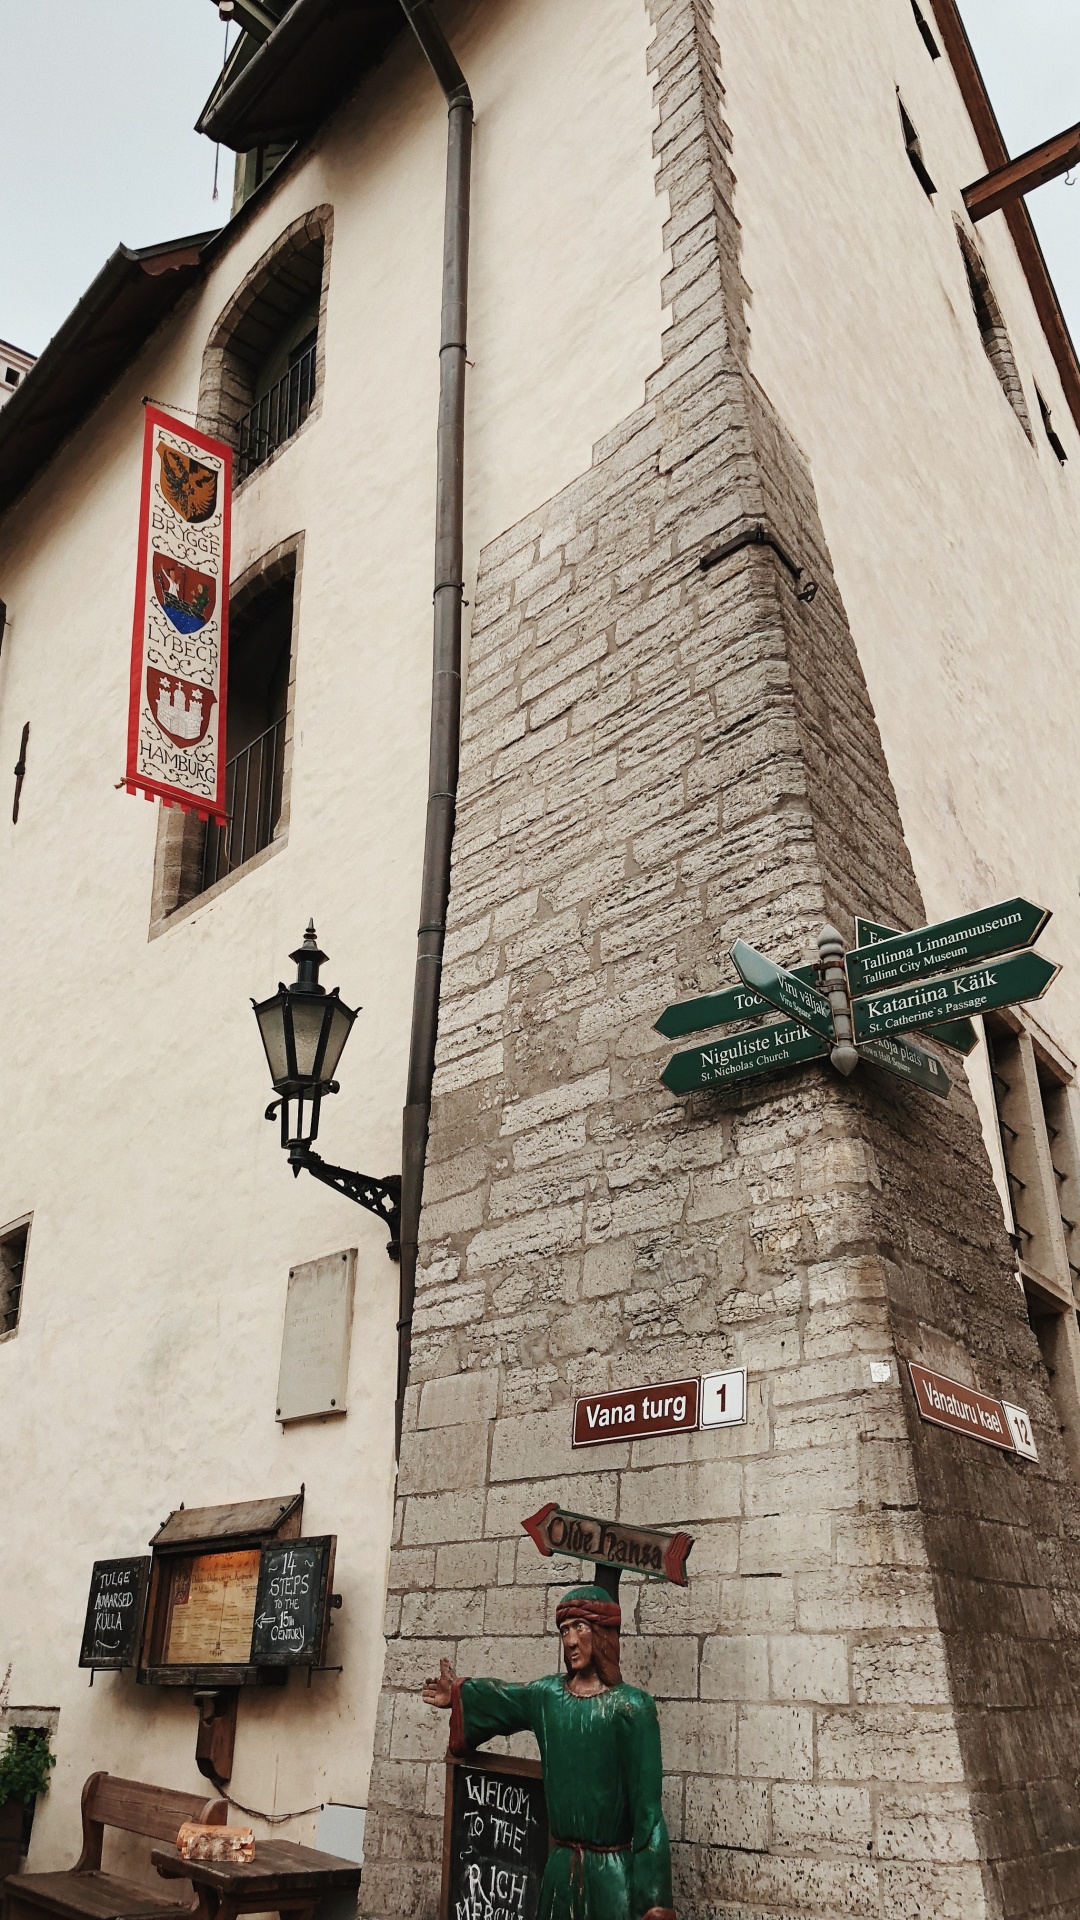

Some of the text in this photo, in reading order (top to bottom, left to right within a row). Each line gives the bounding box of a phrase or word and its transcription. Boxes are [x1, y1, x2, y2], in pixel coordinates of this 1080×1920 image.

[152, 512, 220, 557] BRYGGE
[148, 623, 218, 668] LYBECK
[140, 739, 215, 784] HAMBURG
[861, 911, 1023, 971] Tallinna Linnamuuseum
[863, 946, 968, 985] Tallinn City Museum
[776, 972, 828, 1018] Viru väljak
[779, 992, 812, 1020] Viru Square
[867, 970, 998, 1018] Katariina Käik
[869, 1022, 883, 1033] St.
[945, 994, 988, 1013] Passage
[700, 1024, 812, 1068] Niguliste kirik
[878, 1050, 892, 1064] Hall
[891, 1057, 911, 1073] Square
[900, 1046, 922, 1067] plats
[701, 1049, 790, 1082] St. Nicholas Church
[586, 1395, 687, 1428] Vana turg
[716, 1384, 727, 1412] 1
[922, 1379, 1004, 1435] Vanaturu kael
[1013, 1416, 1031, 1446] 12
[546, 1517, 594, 1554] Olde
[100, 1571, 131, 1589] TULGE
[281, 1551, 297, 1575] 14
[269, 1574, 309, 1596] STEPS
[274, 1598, 300, 1610] TO THE
[94, 1609, 123, 1631] KÜLLA
[465, 1775, 533, 1821] WELCOM
[464, 1811, 527, 1855] TO THE
[468, 1863, 528, 1909] RICH
